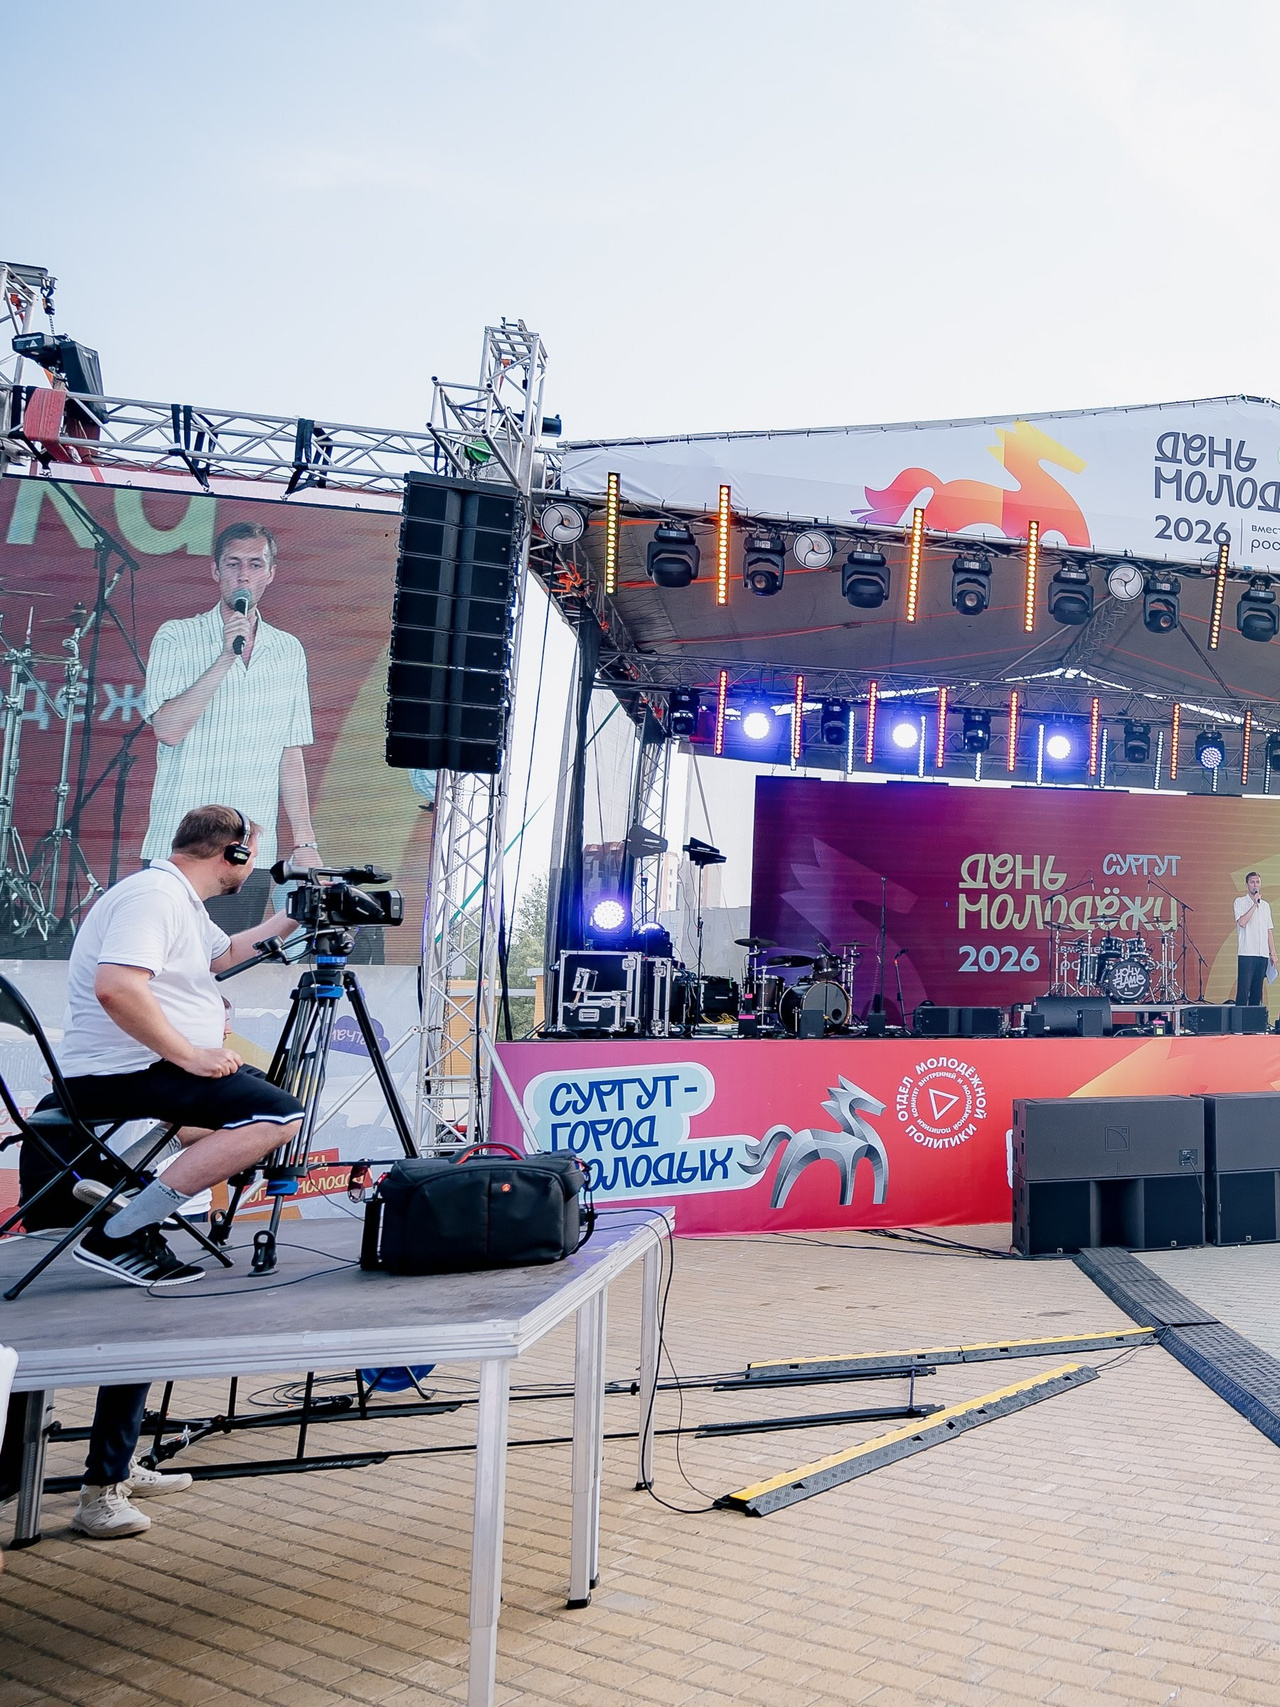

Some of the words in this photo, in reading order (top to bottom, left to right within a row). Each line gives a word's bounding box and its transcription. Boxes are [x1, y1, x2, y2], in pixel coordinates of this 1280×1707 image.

[1154, 515, 1232, 545] 2026
[1103, 853, 1181, 876] СУРГУТ
[958, 945, 1040, 972] 2026
[896, 1076, 914, 1121] ОТДЕЛ
[915, 1056, 987, 1119] МОЛОДЁЖНОЙ
[551, 1115, 659, 1154] ГОРОД
[905, 1123, 977, 1149] ПОЛИТИКИ
[583, 1147, 734, 1192] ОЛОДЫХ
